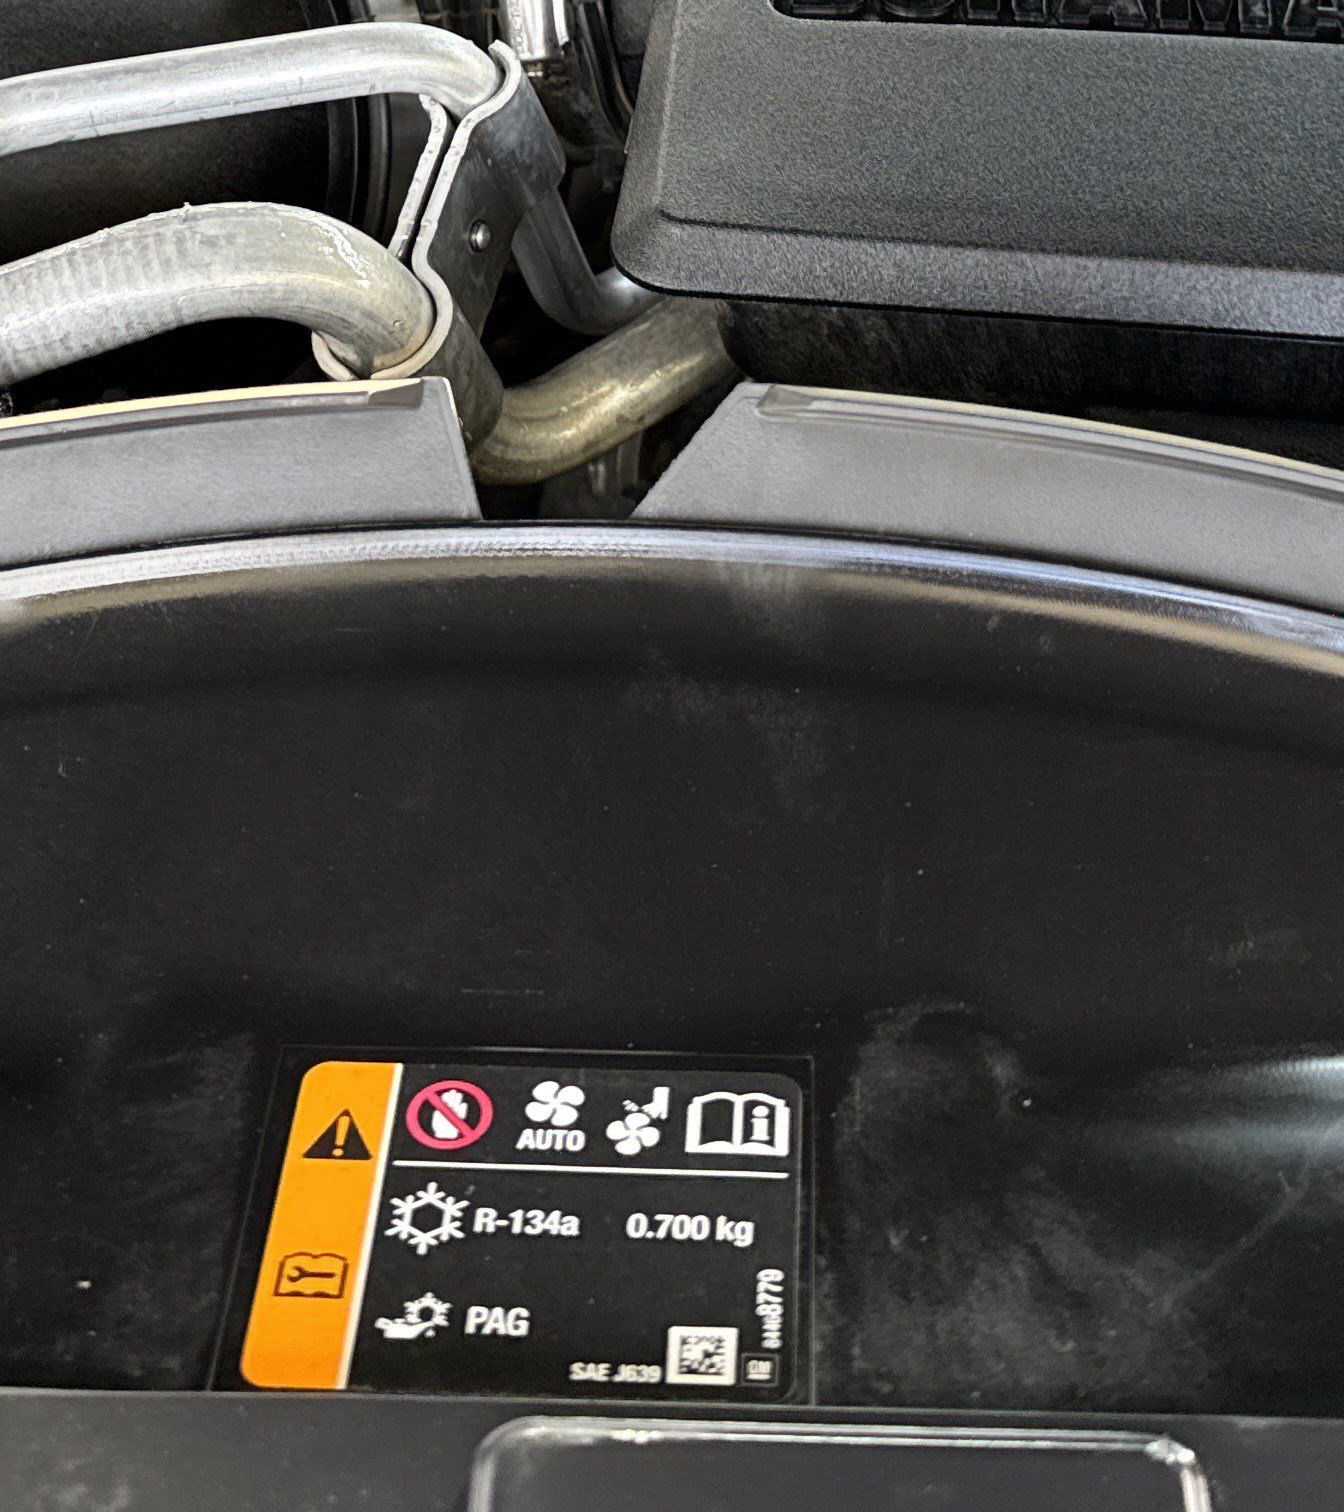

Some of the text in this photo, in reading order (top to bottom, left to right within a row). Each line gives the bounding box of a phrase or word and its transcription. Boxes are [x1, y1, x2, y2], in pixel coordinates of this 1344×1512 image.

[515, 1128, 587, 1152] AUTO
[472, 1206, 755, 1248] R-134a 0.700 kg
[464, 1305, 531, 1337] PAG
[569, 1361, 611, 1382] SAE
